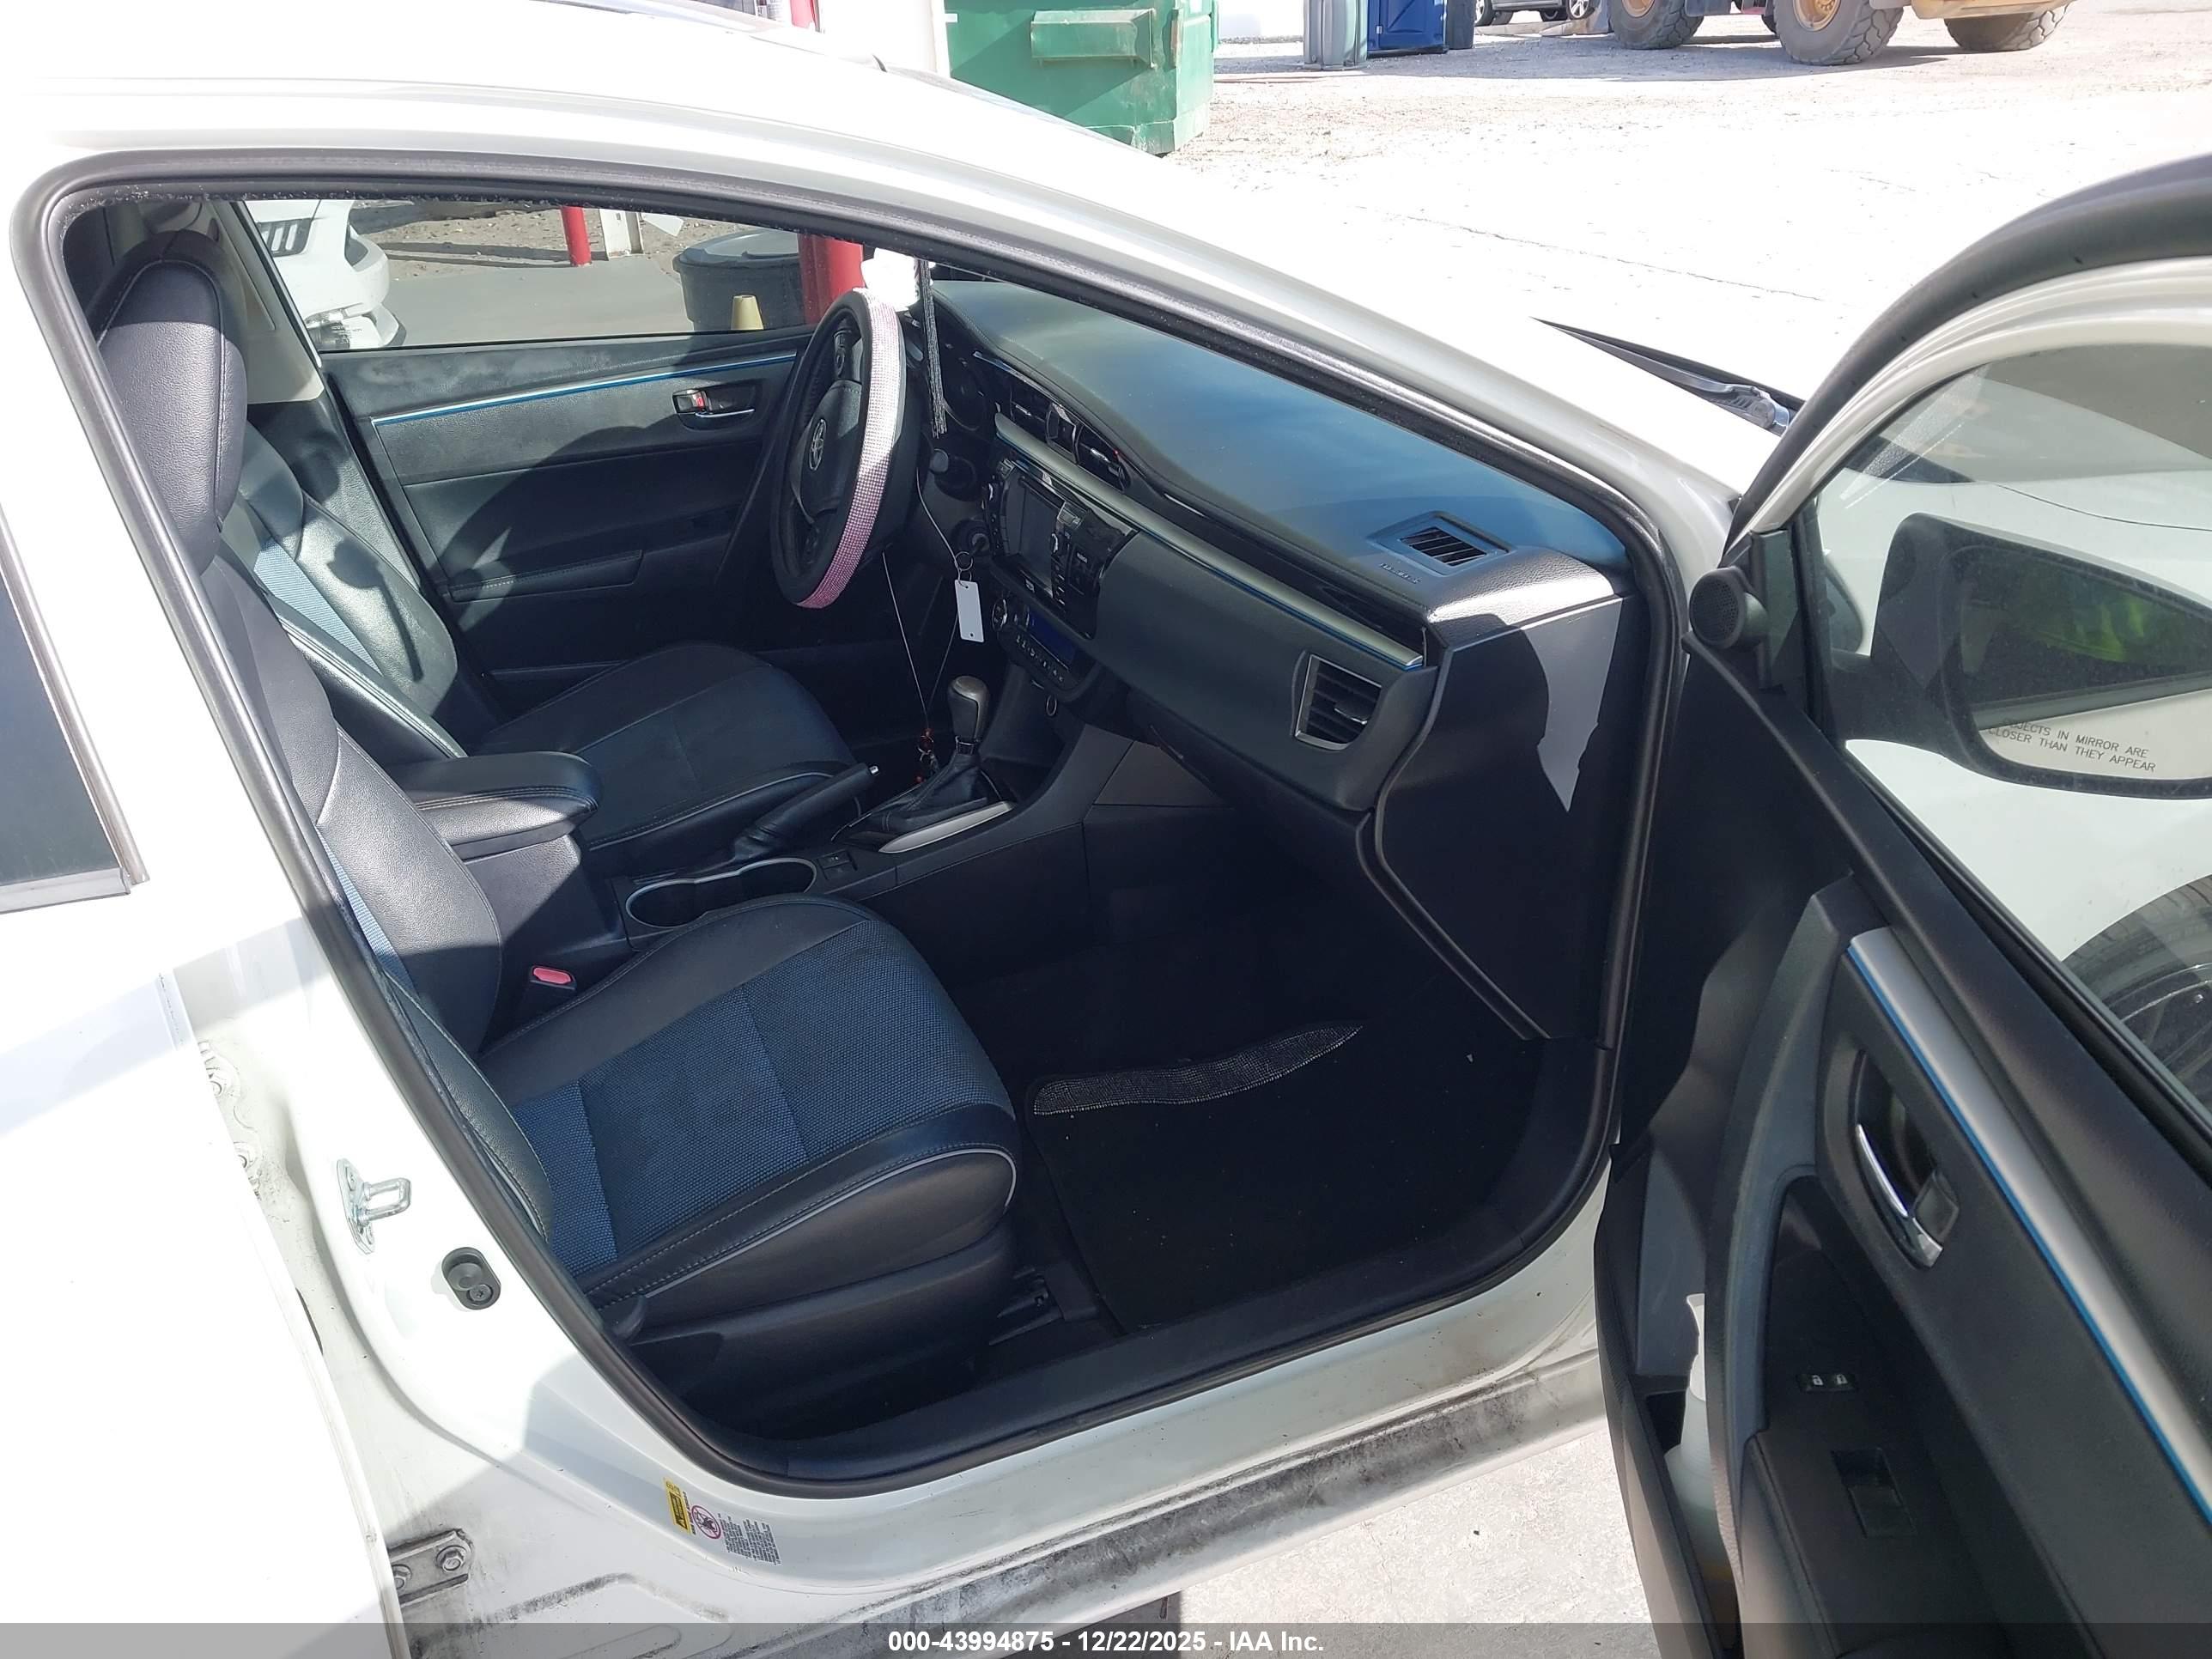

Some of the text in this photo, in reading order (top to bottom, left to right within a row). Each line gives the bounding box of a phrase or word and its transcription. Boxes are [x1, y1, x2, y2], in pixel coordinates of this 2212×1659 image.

[2003, 718, 2149, 758] JECTS IN MIRROR ARE
[2039, 737, 2068, 751] THAN
[2075, 745, 2105, 760] THEY
[2109, 755, 2156, 773] APPEAR
